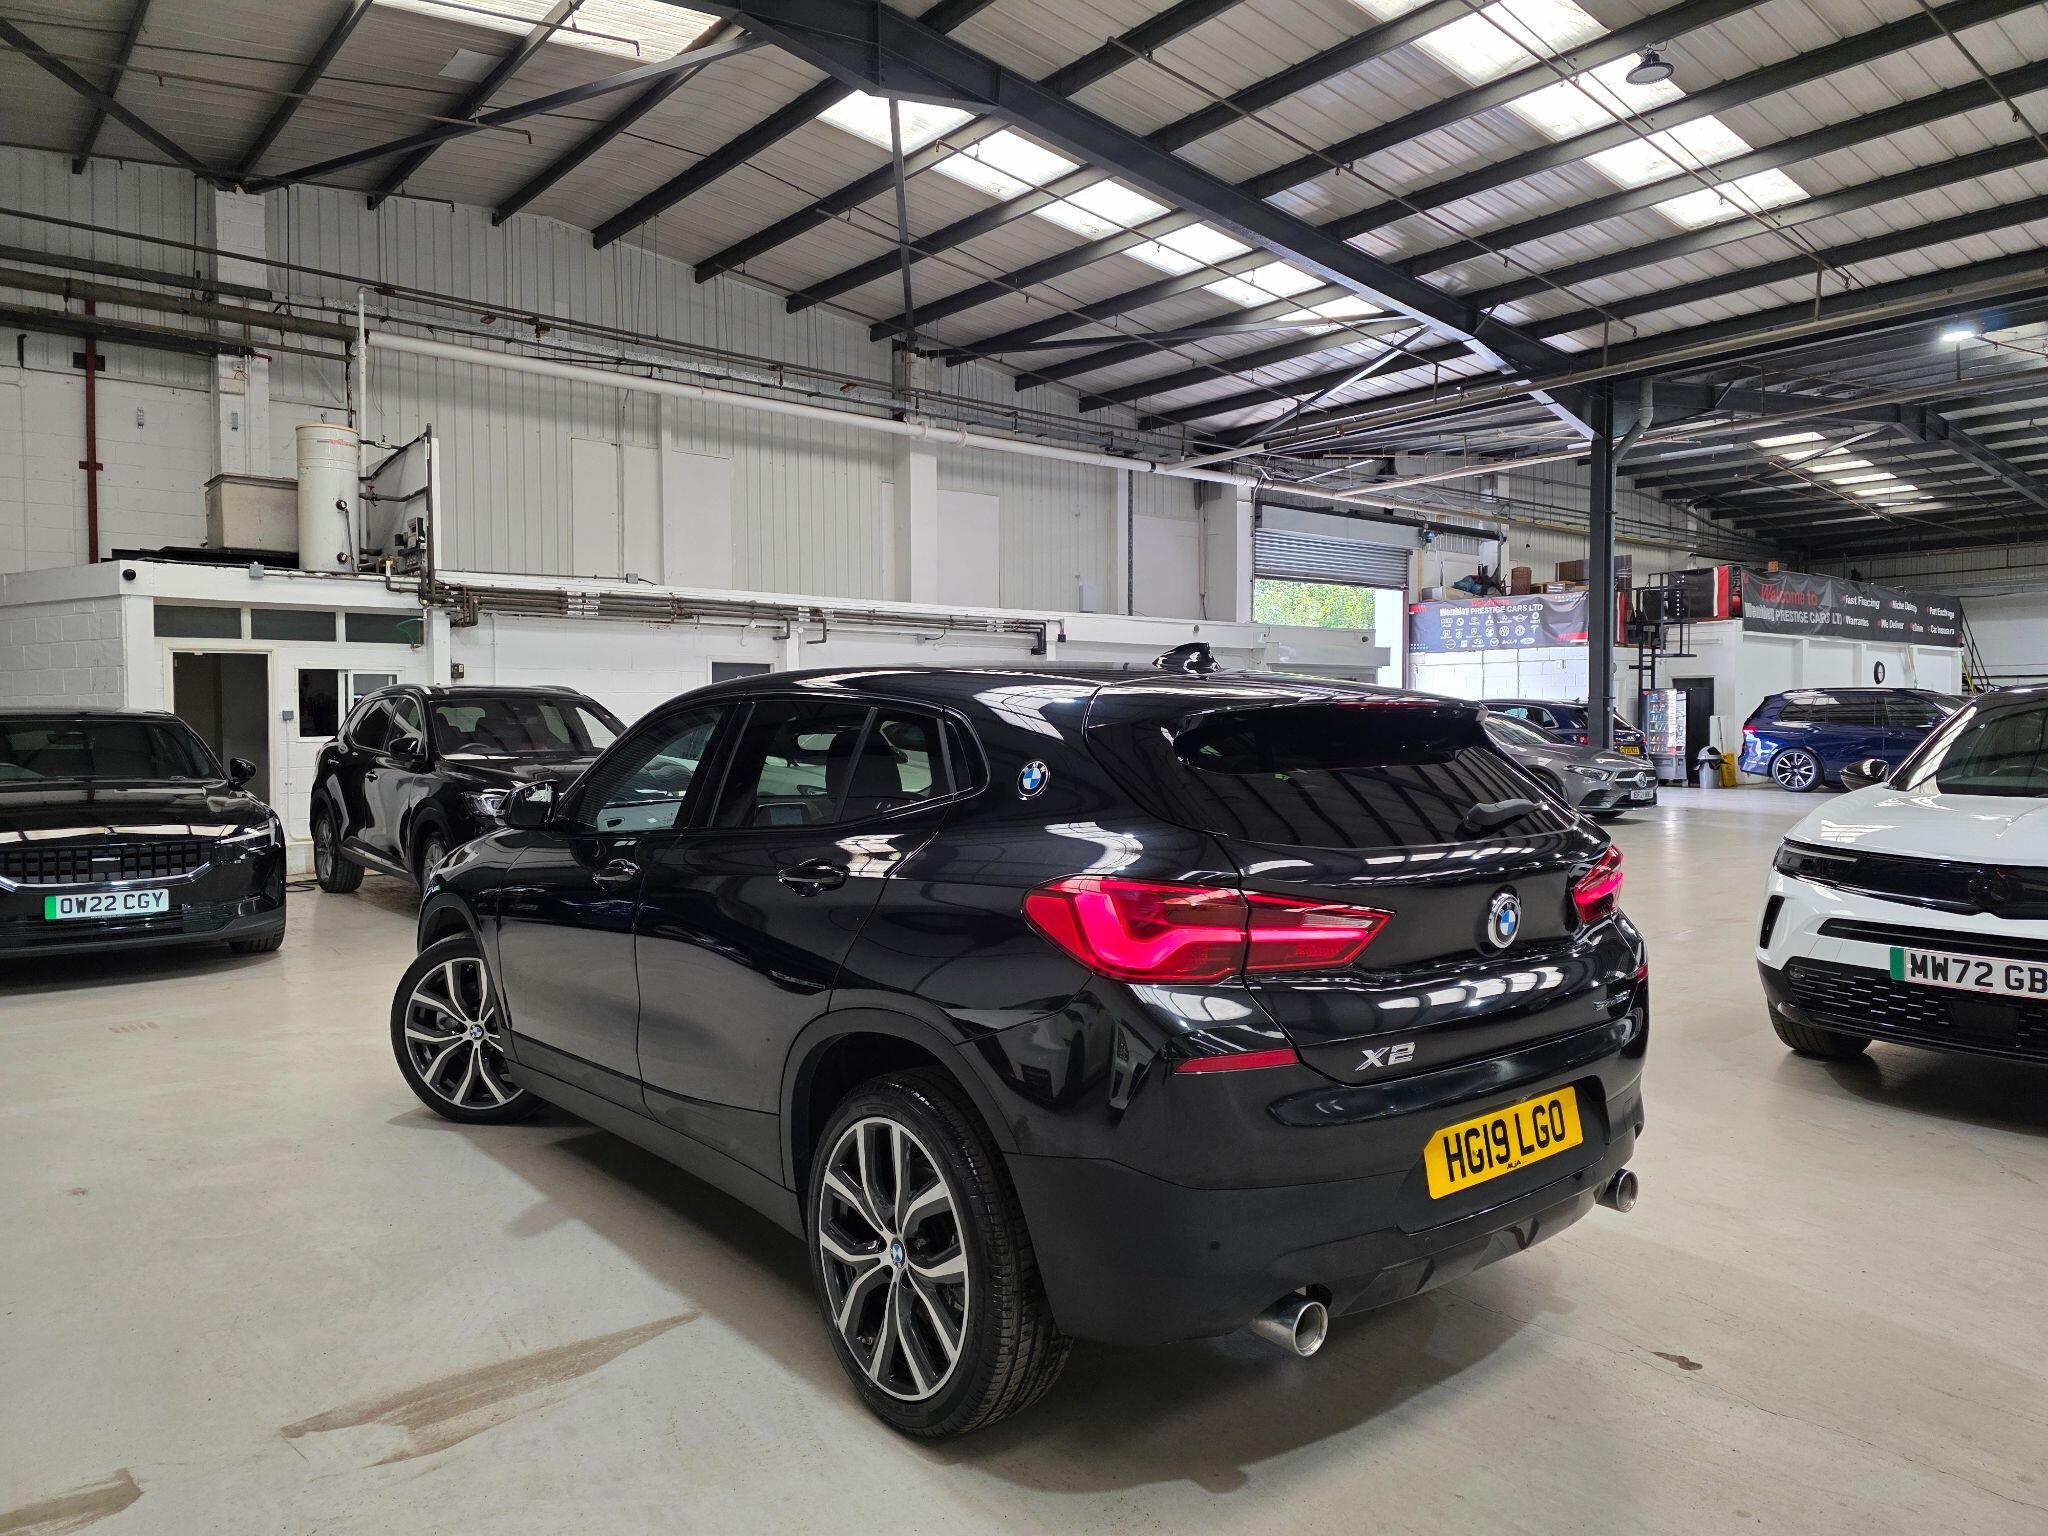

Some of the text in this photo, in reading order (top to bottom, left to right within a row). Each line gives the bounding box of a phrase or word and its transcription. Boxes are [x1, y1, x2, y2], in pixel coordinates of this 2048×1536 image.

[1760, 583, 1818, 607] Welcome to
[1470, 606, 1505, 615] PRESTIGE
[1506, 604, 1528, 613] CARS
[1529, 603, 1544, 612] LTD
[1775, 608, 1808, 623] PRESTIGE
[1809, 612, 1831, 624] CARS
[59, 891, 164, 914] OW22 CGY
[1910, 953, 1994, 987] MW72
[1354, 1041, 1416, 1071] X2
[1443, 1099, 1566, 1183] HG19 LGO
